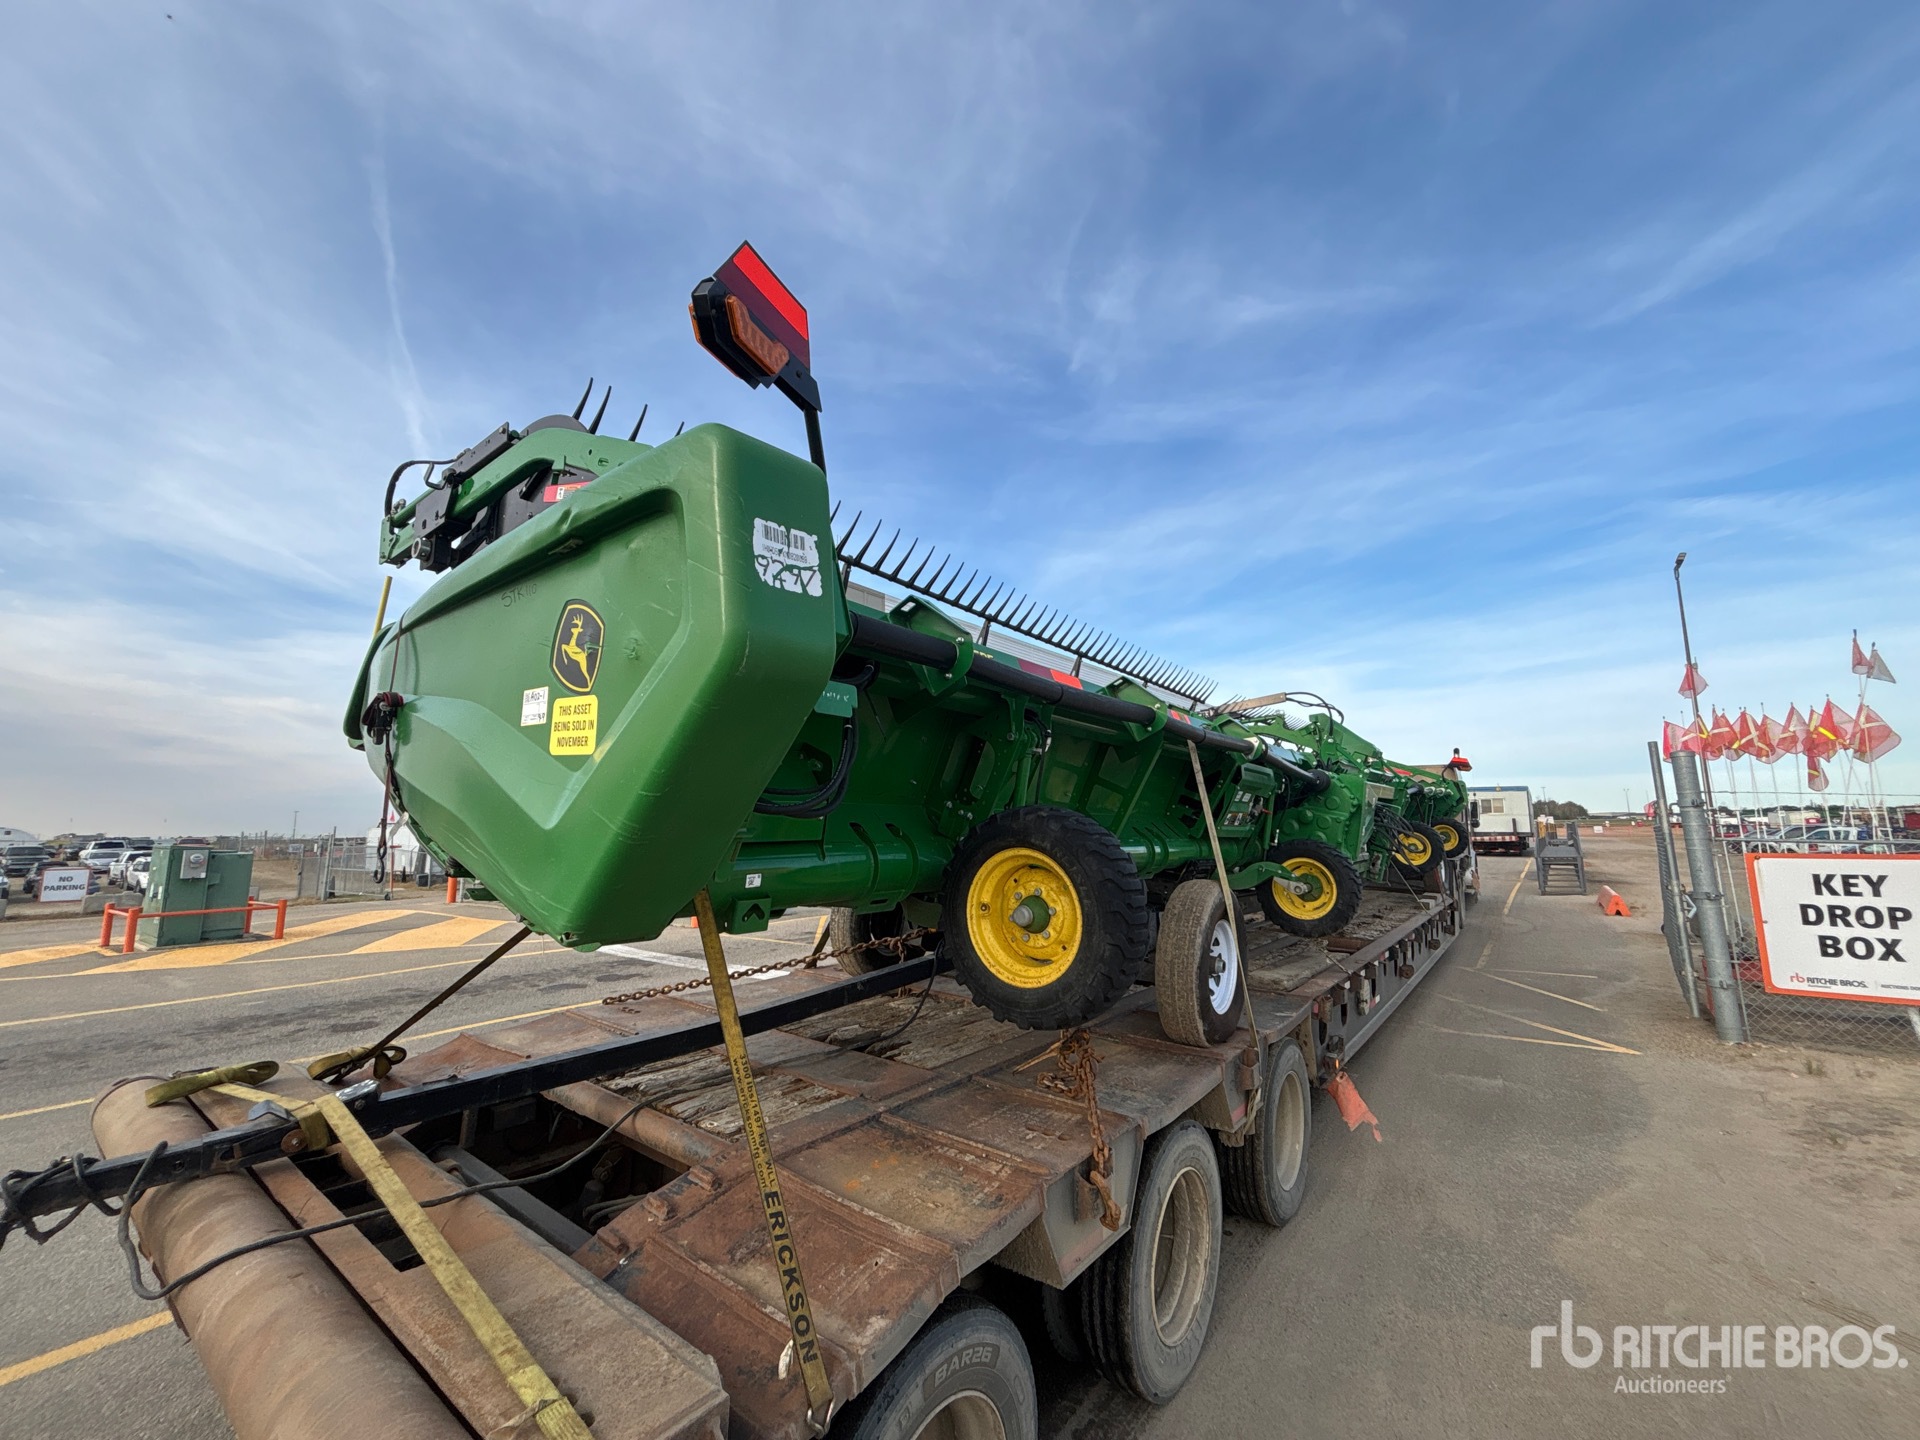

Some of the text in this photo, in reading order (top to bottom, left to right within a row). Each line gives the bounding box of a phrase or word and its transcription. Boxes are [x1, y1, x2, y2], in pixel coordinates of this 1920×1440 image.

[559, 703, 592, 716] THIS ASSET
[553, 719, 595, 732] BEING SOLD IN
[556, 736, 589, 748] NOVEMBER
[1812, 873, 1889, 898] KEY
[1799, 903, 1913, 930] DROP
[1817, 934, 1907, 963] BOX
[1806, 976, 1839, 986] RITCHIE
[733, 1058, 767, 1189] www.ericksonmfg.com
[740, 1053, 751, 1079] 3300
[758, 1131, 767, 1154] kgs
[765, 1159, 776, 1188] WLL
[764, 1190, 818, 1364] ERICKSON
[935, 1346, 993, 1388] BAR26
